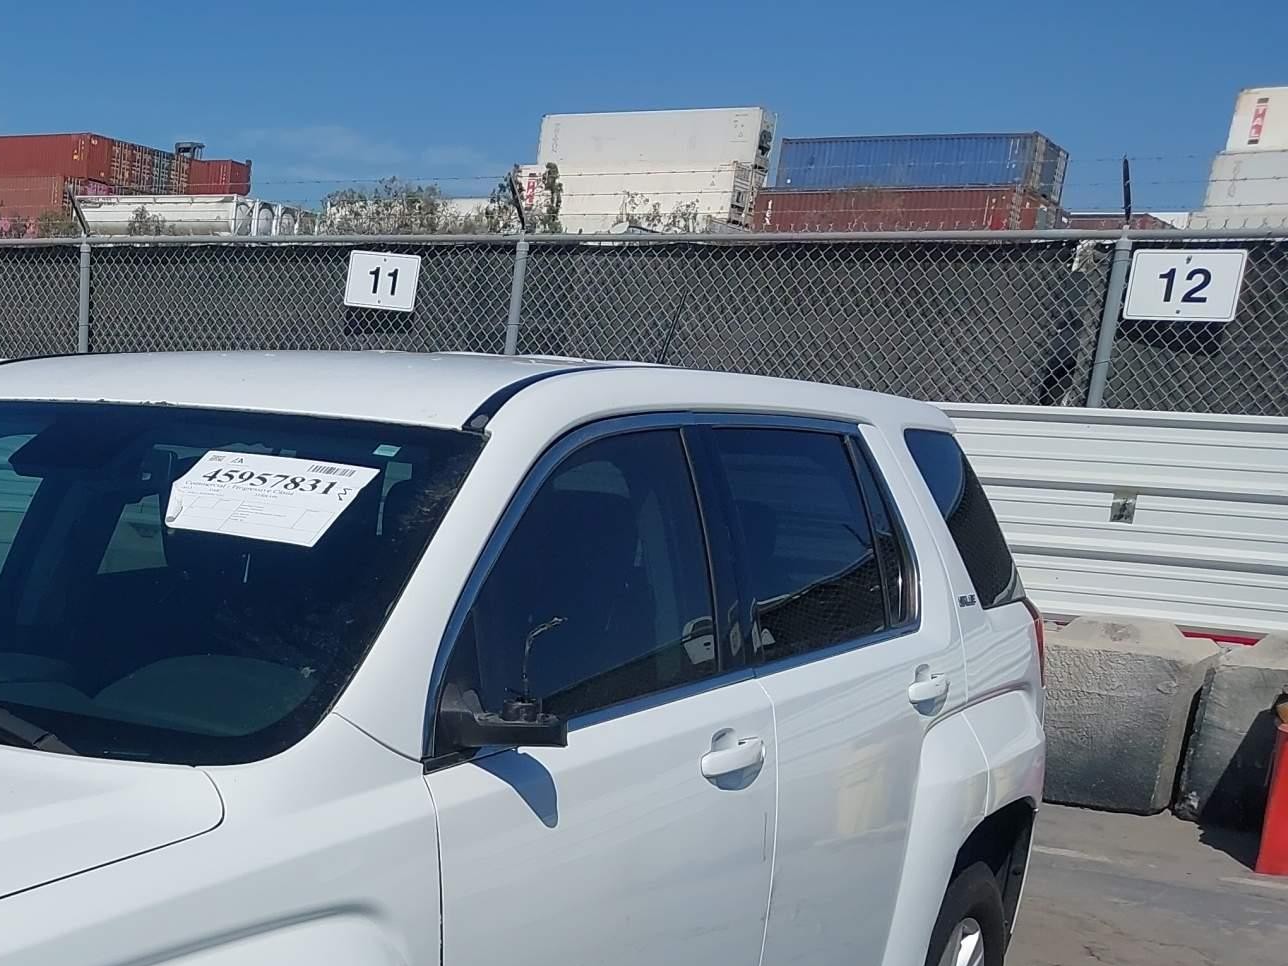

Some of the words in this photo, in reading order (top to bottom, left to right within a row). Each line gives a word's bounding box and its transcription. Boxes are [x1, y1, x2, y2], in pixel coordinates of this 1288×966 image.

[369, 266, 399, 296] 11
[1158, 267, 1212, 303] 12
[202, 467, 338, 496] 45957831
